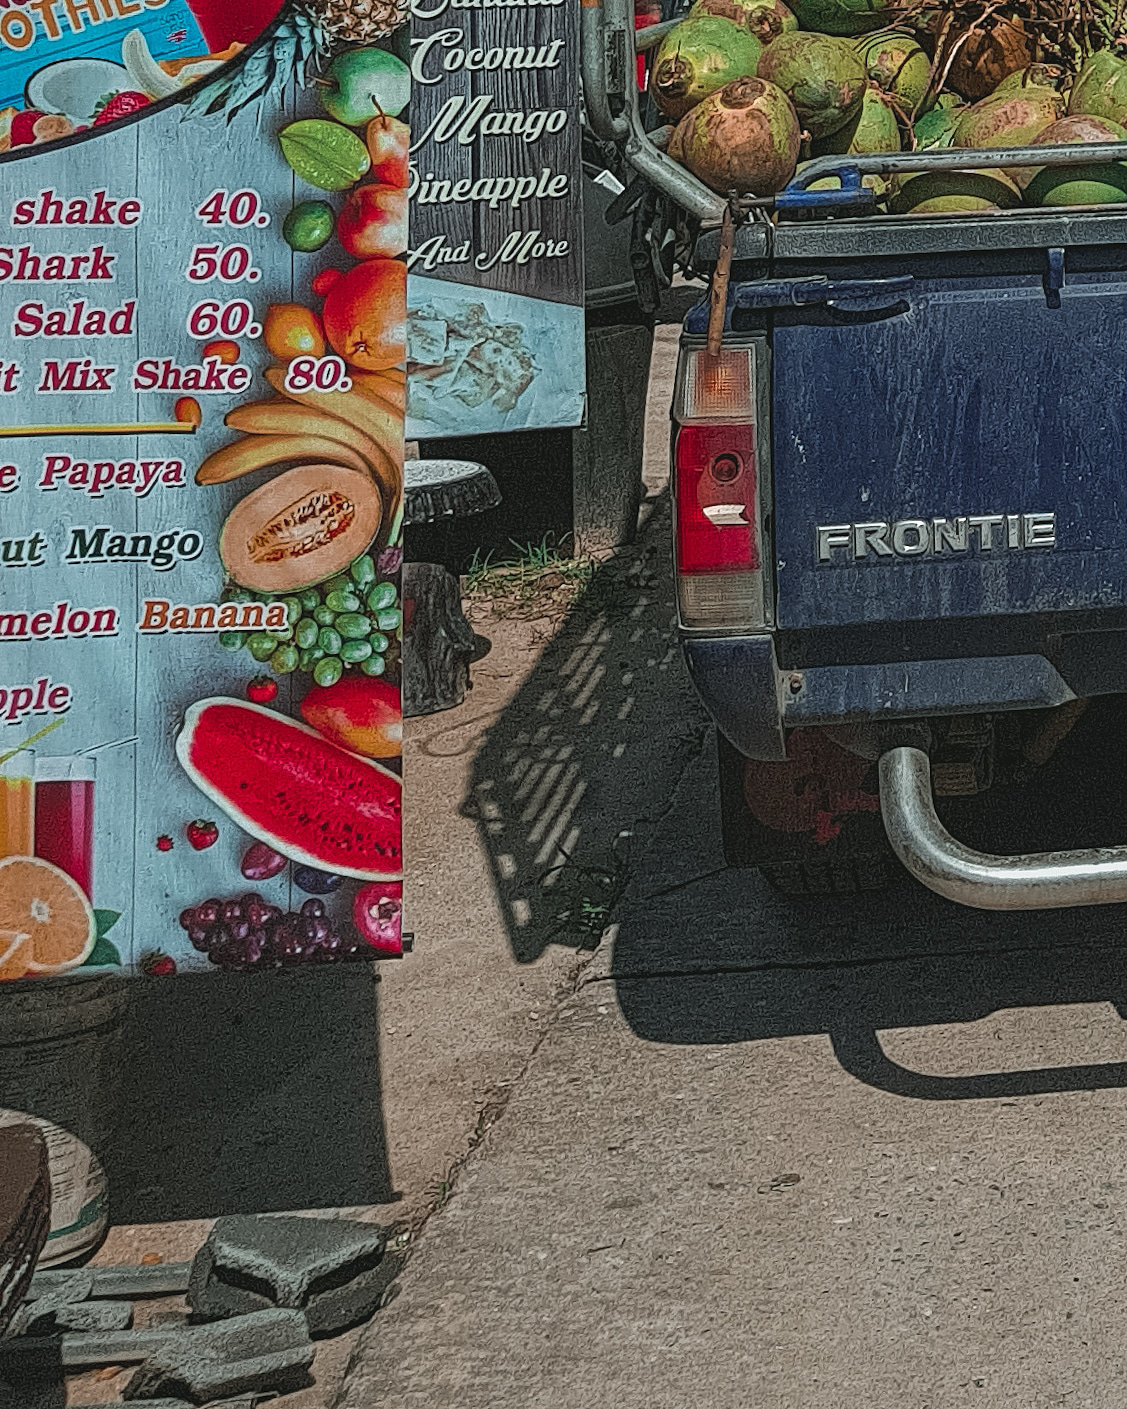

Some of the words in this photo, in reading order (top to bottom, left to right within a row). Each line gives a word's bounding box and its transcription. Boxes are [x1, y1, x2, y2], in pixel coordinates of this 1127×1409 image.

[410, 28, 565, 84] Coconut
[409, 94, 567, 153] Mango
[13, 192, 141, 225] shake
[198, 192, 269, 225] 40.
[0, 246, 115, 281] Shark
[187, 246, 259, 281] 50.
[407, 235, 470, 270] And
[474, 230, 569, 271] More
[14, 302, 136, 337] Salad
[189, 302, 260, 336] 60.
[0, 360, 20, 392] t
[39, 361, 114, 391] Mix
[134, 359, 249, 391] Shake
[288, 360, 351, 390] 80.
[39, 456, 184, 494] Papaya
[66, 528, 203, 563] Mango
[817, 512, 1056, 563] FRONTIE
[0, 603, 118, 635] melon
[140, 601, 286, 630] Banana
